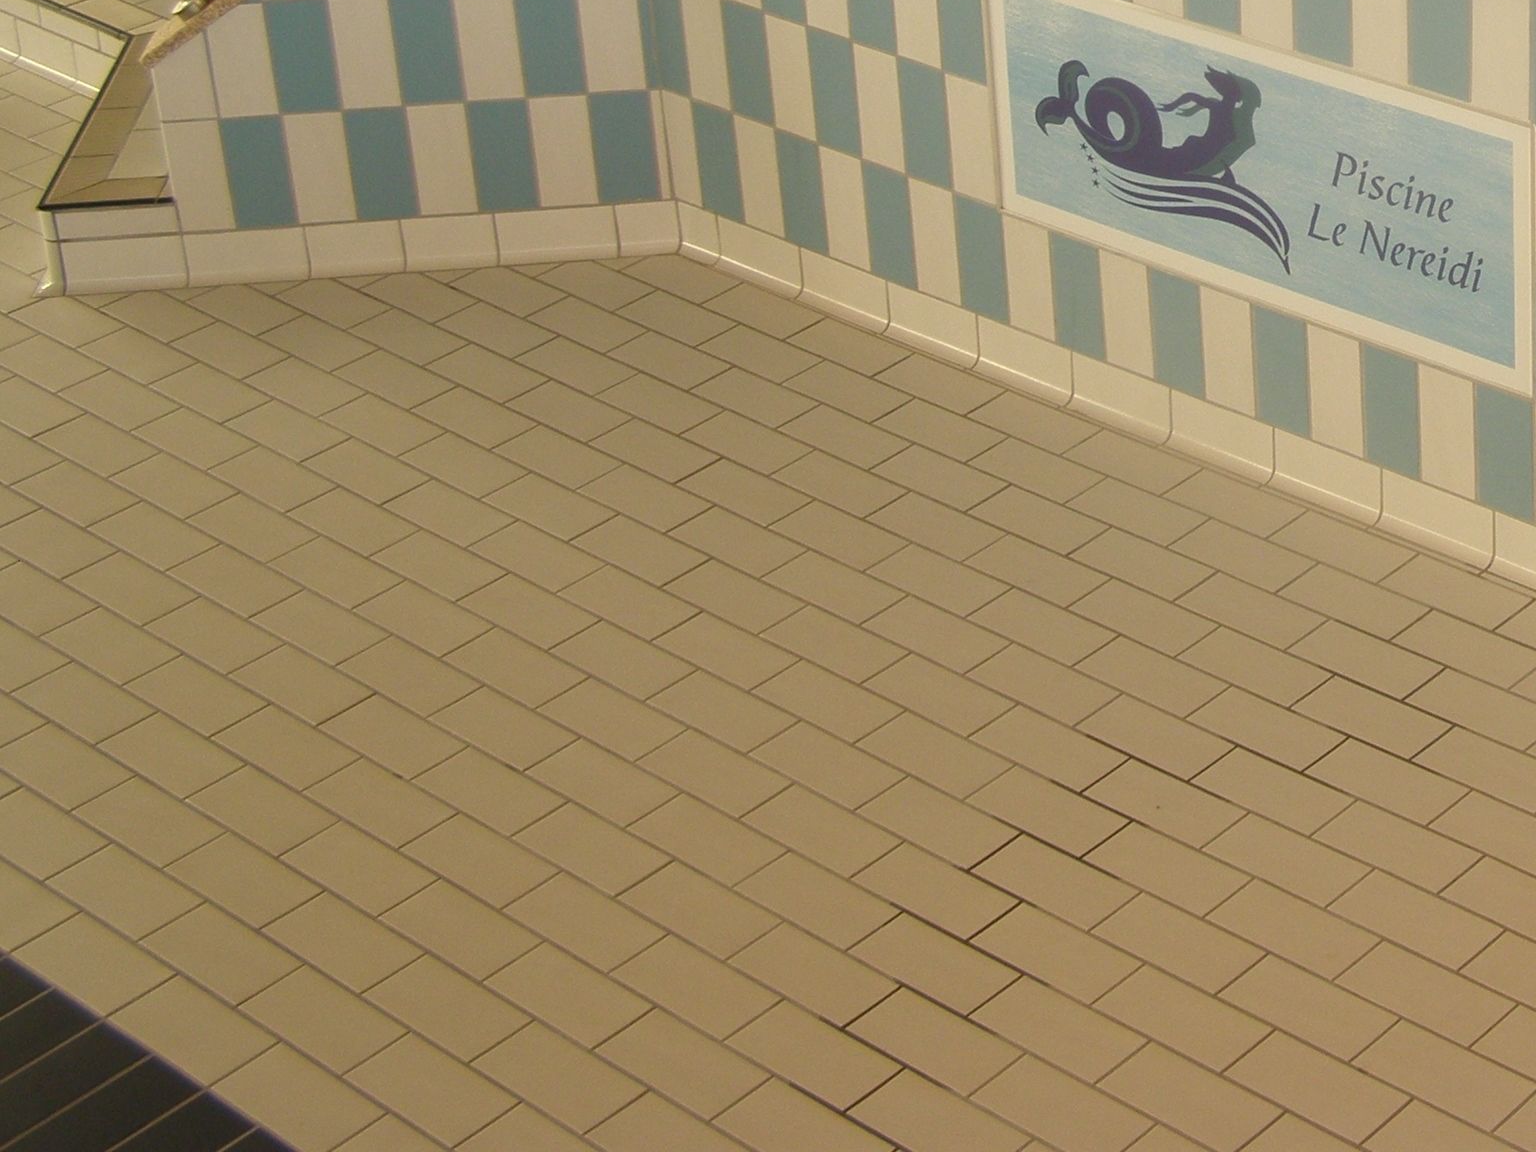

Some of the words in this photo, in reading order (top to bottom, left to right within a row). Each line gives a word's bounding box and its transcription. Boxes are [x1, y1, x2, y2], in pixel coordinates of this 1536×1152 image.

[1332, 151, 1454, 223] Piscine
[1307, 203, 1347, 247] Le
[1359, 219, 1484, 292] Nereidi
